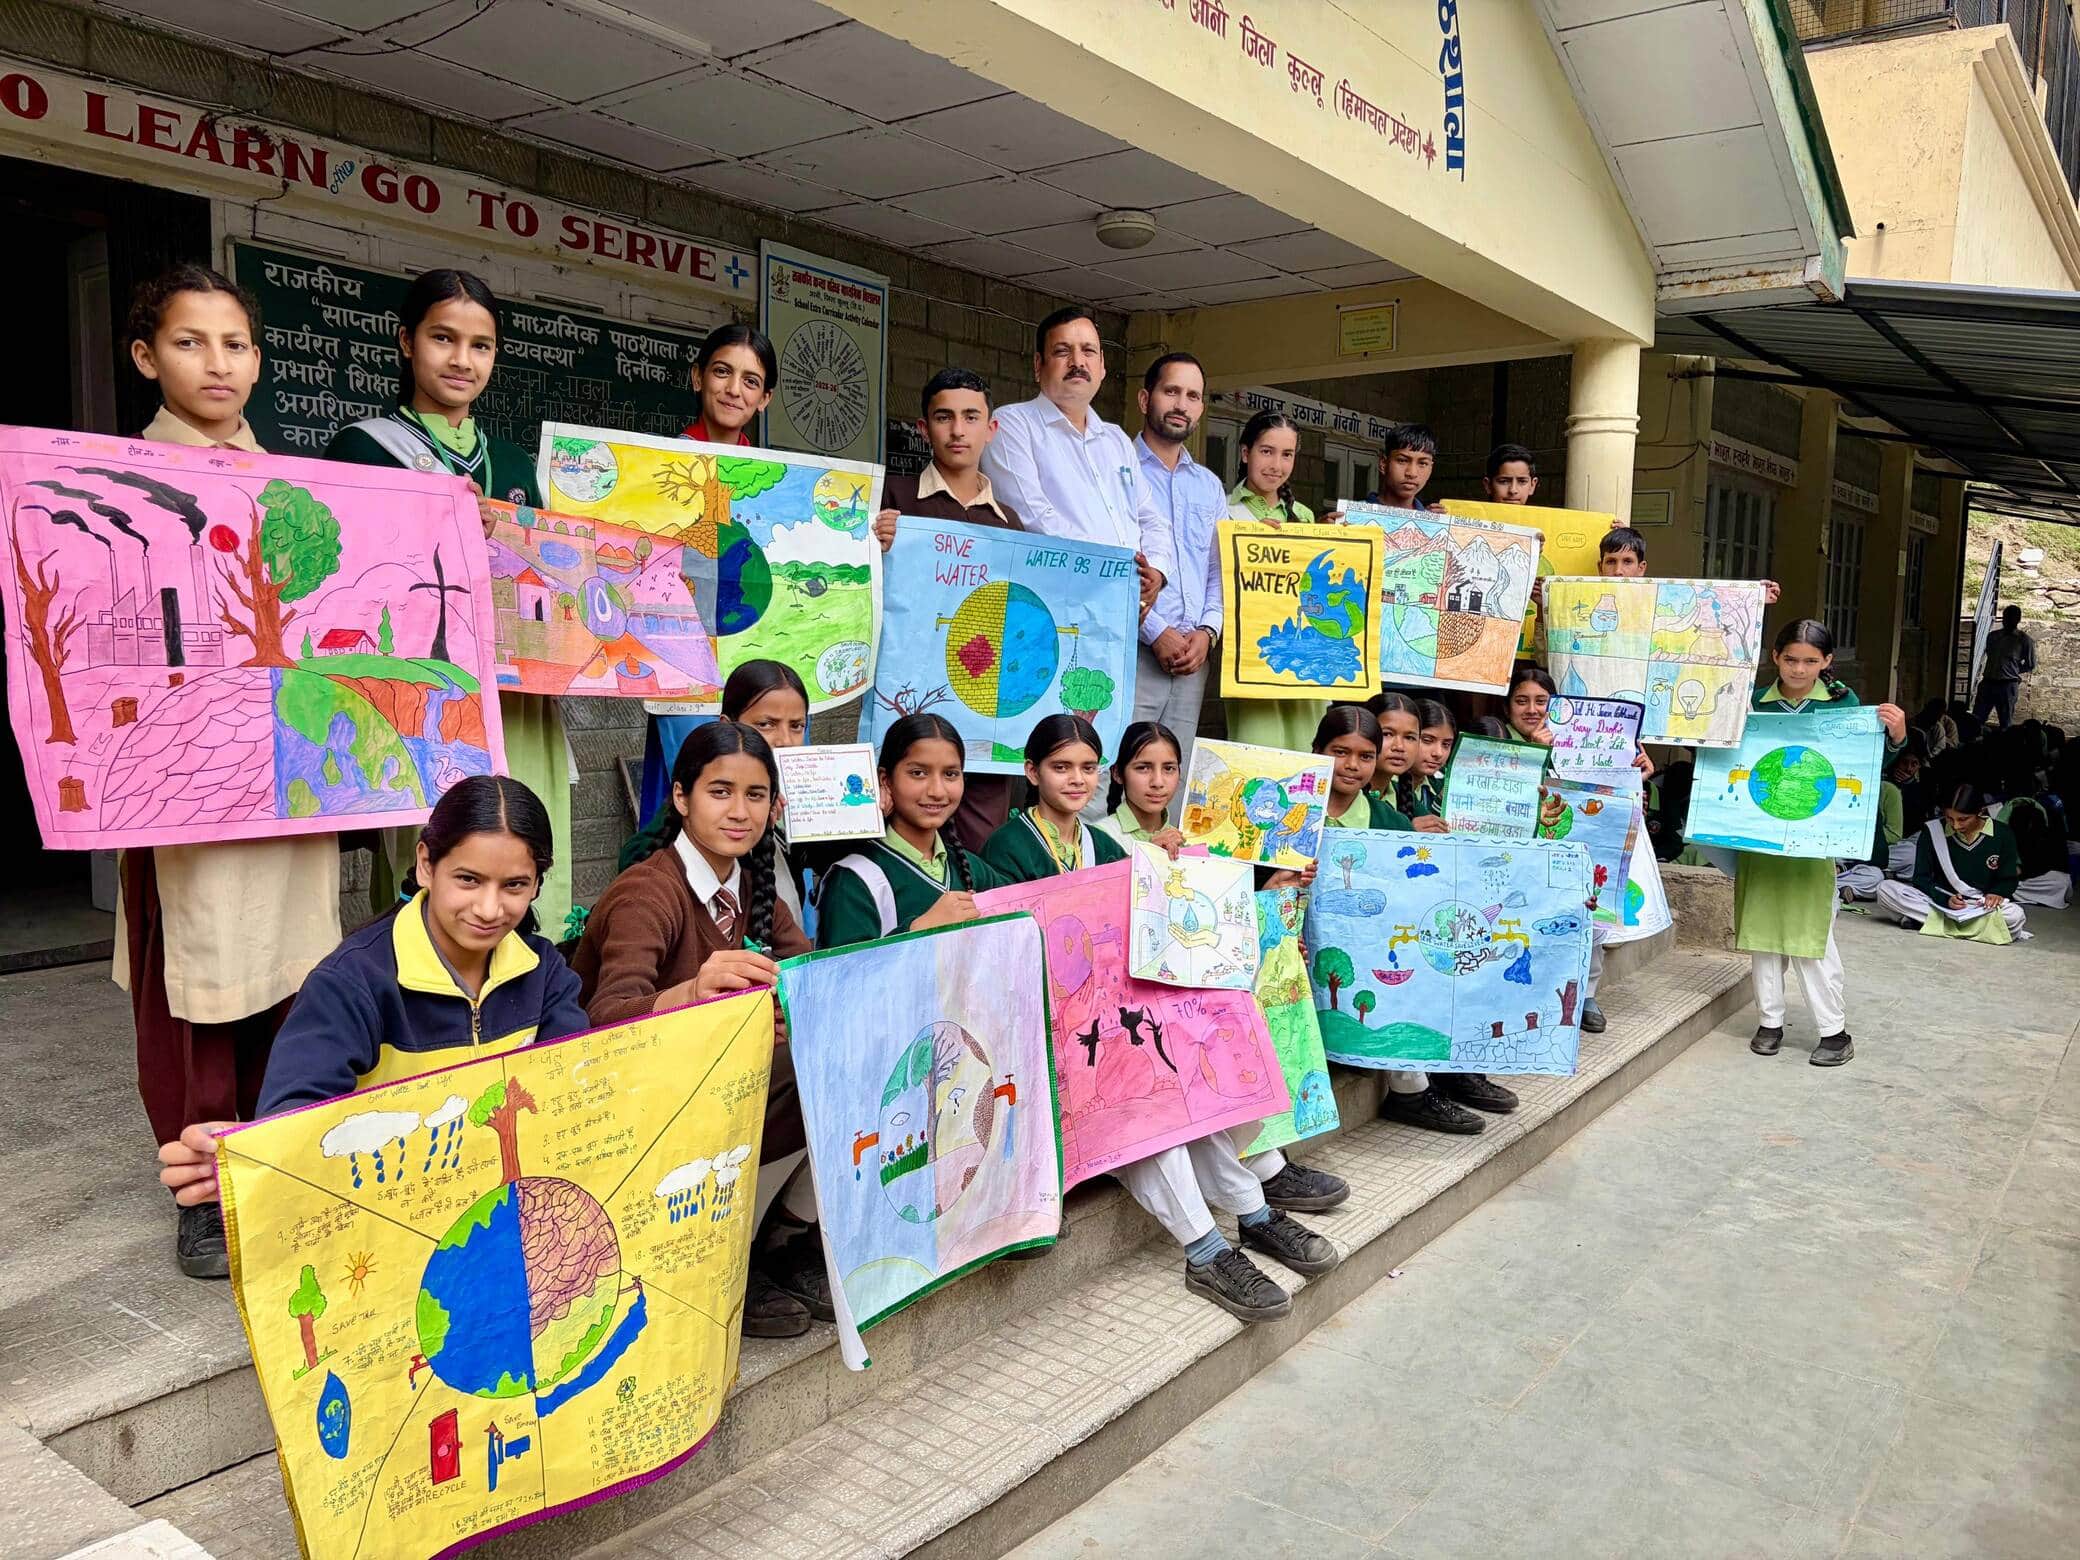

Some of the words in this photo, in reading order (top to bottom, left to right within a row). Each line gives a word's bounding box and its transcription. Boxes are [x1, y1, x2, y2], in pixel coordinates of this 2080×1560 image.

[1239, 15, 1277, 69] जिला
[1286, 52, 1325, 109] कुल्लू
[1333, 79, 1390, 136] (हिमाचल
[83, 91, 329, 189] LEARN
[329, 160, 355, 194] AND
[361, 164, 441, 214] GO
[468, 189, 540, 238] TO
[560, 214, 717, 282] SERVE
[263, 261, 365, 300] राजकीय
[512, 311, 600, 346] माध्यमिक
[608, 329, 680, 361] पाठशाला
[794, 297, 809, 310] School
[810, 302, 821, 313] Extra
[845, 313, 861, 328] Activity
[264, 325, 341, 361] कार्यरत
[270, 358, 337, 389] प्रभारी
[1292, 401, 1328, 426] उठाओ
[1333, 405, 1361, 434] गंदगी
[934, 534, 975, 558] SAVE
[1247, 544, 1291, 564] SAVE
[935, 561, 990, 586] WATER
[1026, 550, 1069, 569] WATER
[1099, 561, 1130, 578] LIFE
[1239, 571, 1301, 597] WATER
[1450, 793, 1473, 810] पानी
[1172, 997, 1207, 1019] 70%
